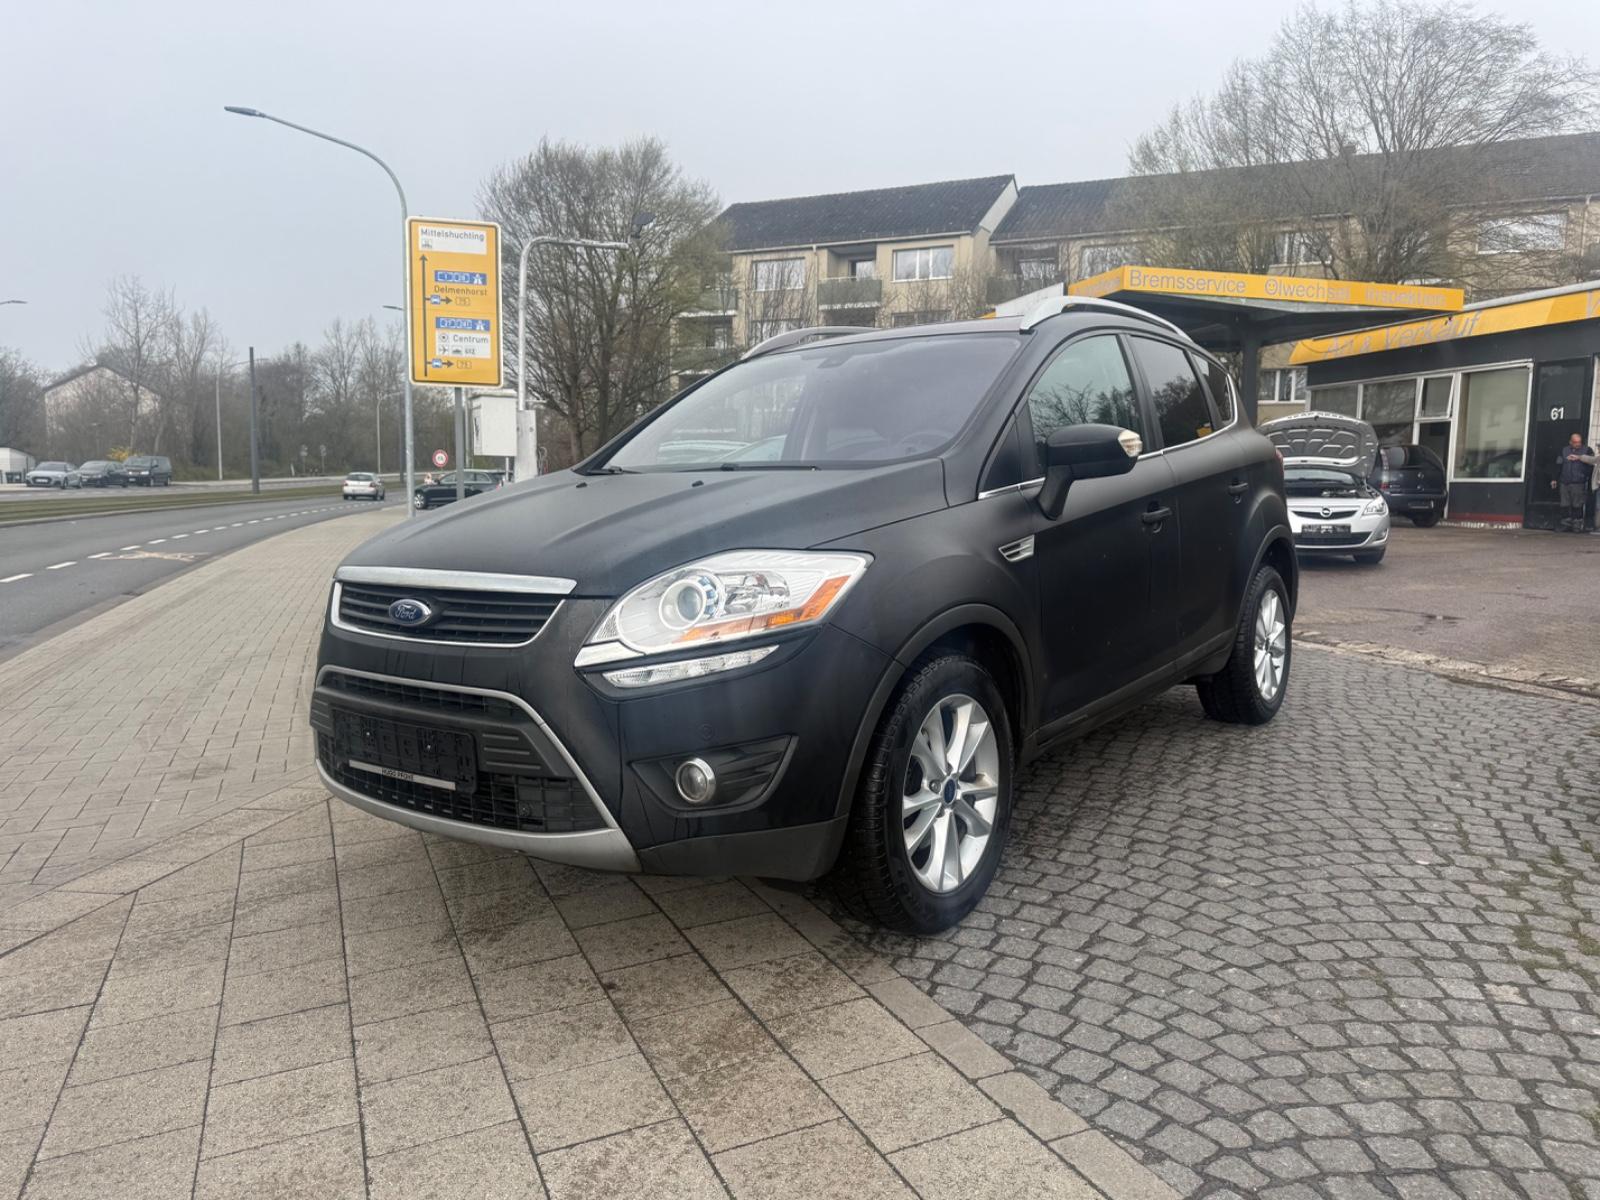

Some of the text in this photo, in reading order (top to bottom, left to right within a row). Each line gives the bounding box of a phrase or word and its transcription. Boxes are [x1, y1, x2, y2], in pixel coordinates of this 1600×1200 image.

[420, 229, 485, 242] Mittelshuchting
[1129, 269, 1247, 294] Bremsservice
[434, 285, 487, 297] Delmenhorst
[1384, 311, 1481, 350] Verkauf
[453, 334, 489, 344] Centrum
[1551, 407, 1564, 420] 61
[395, 604, 417, 619] Ford
